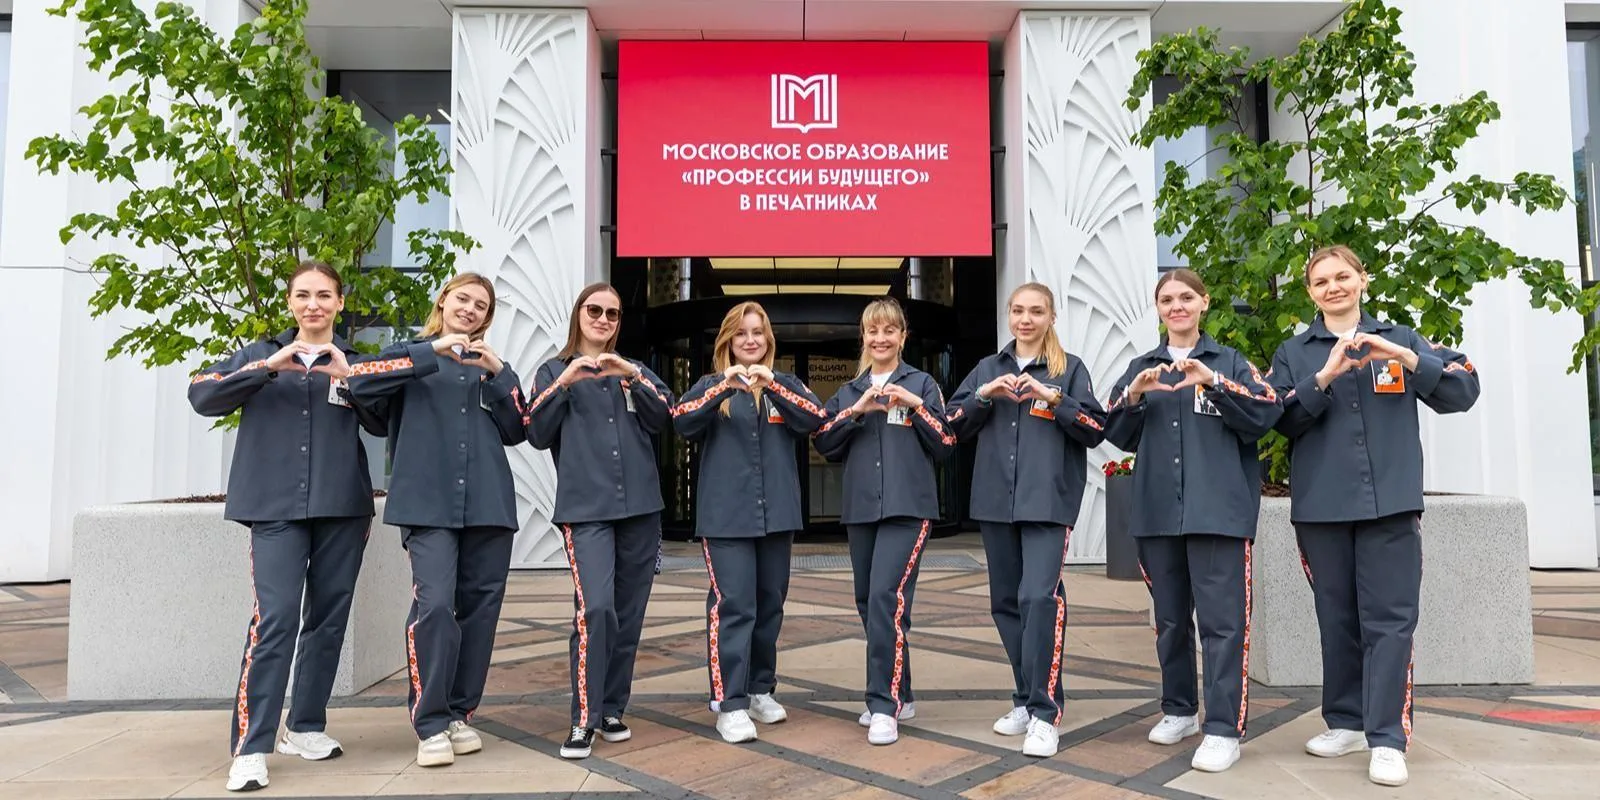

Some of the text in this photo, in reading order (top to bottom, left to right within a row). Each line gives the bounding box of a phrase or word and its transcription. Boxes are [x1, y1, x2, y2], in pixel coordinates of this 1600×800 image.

[662, 144, 949, 160] МОСКОВСКОЕ ОБРАЗОВАНИЕ
[681, 168, 930, 187] «ПРОФЕССИИ БУДУЩЕГО»
[740, 194, 878, 210] В ПЕЧАТНИКАХ
